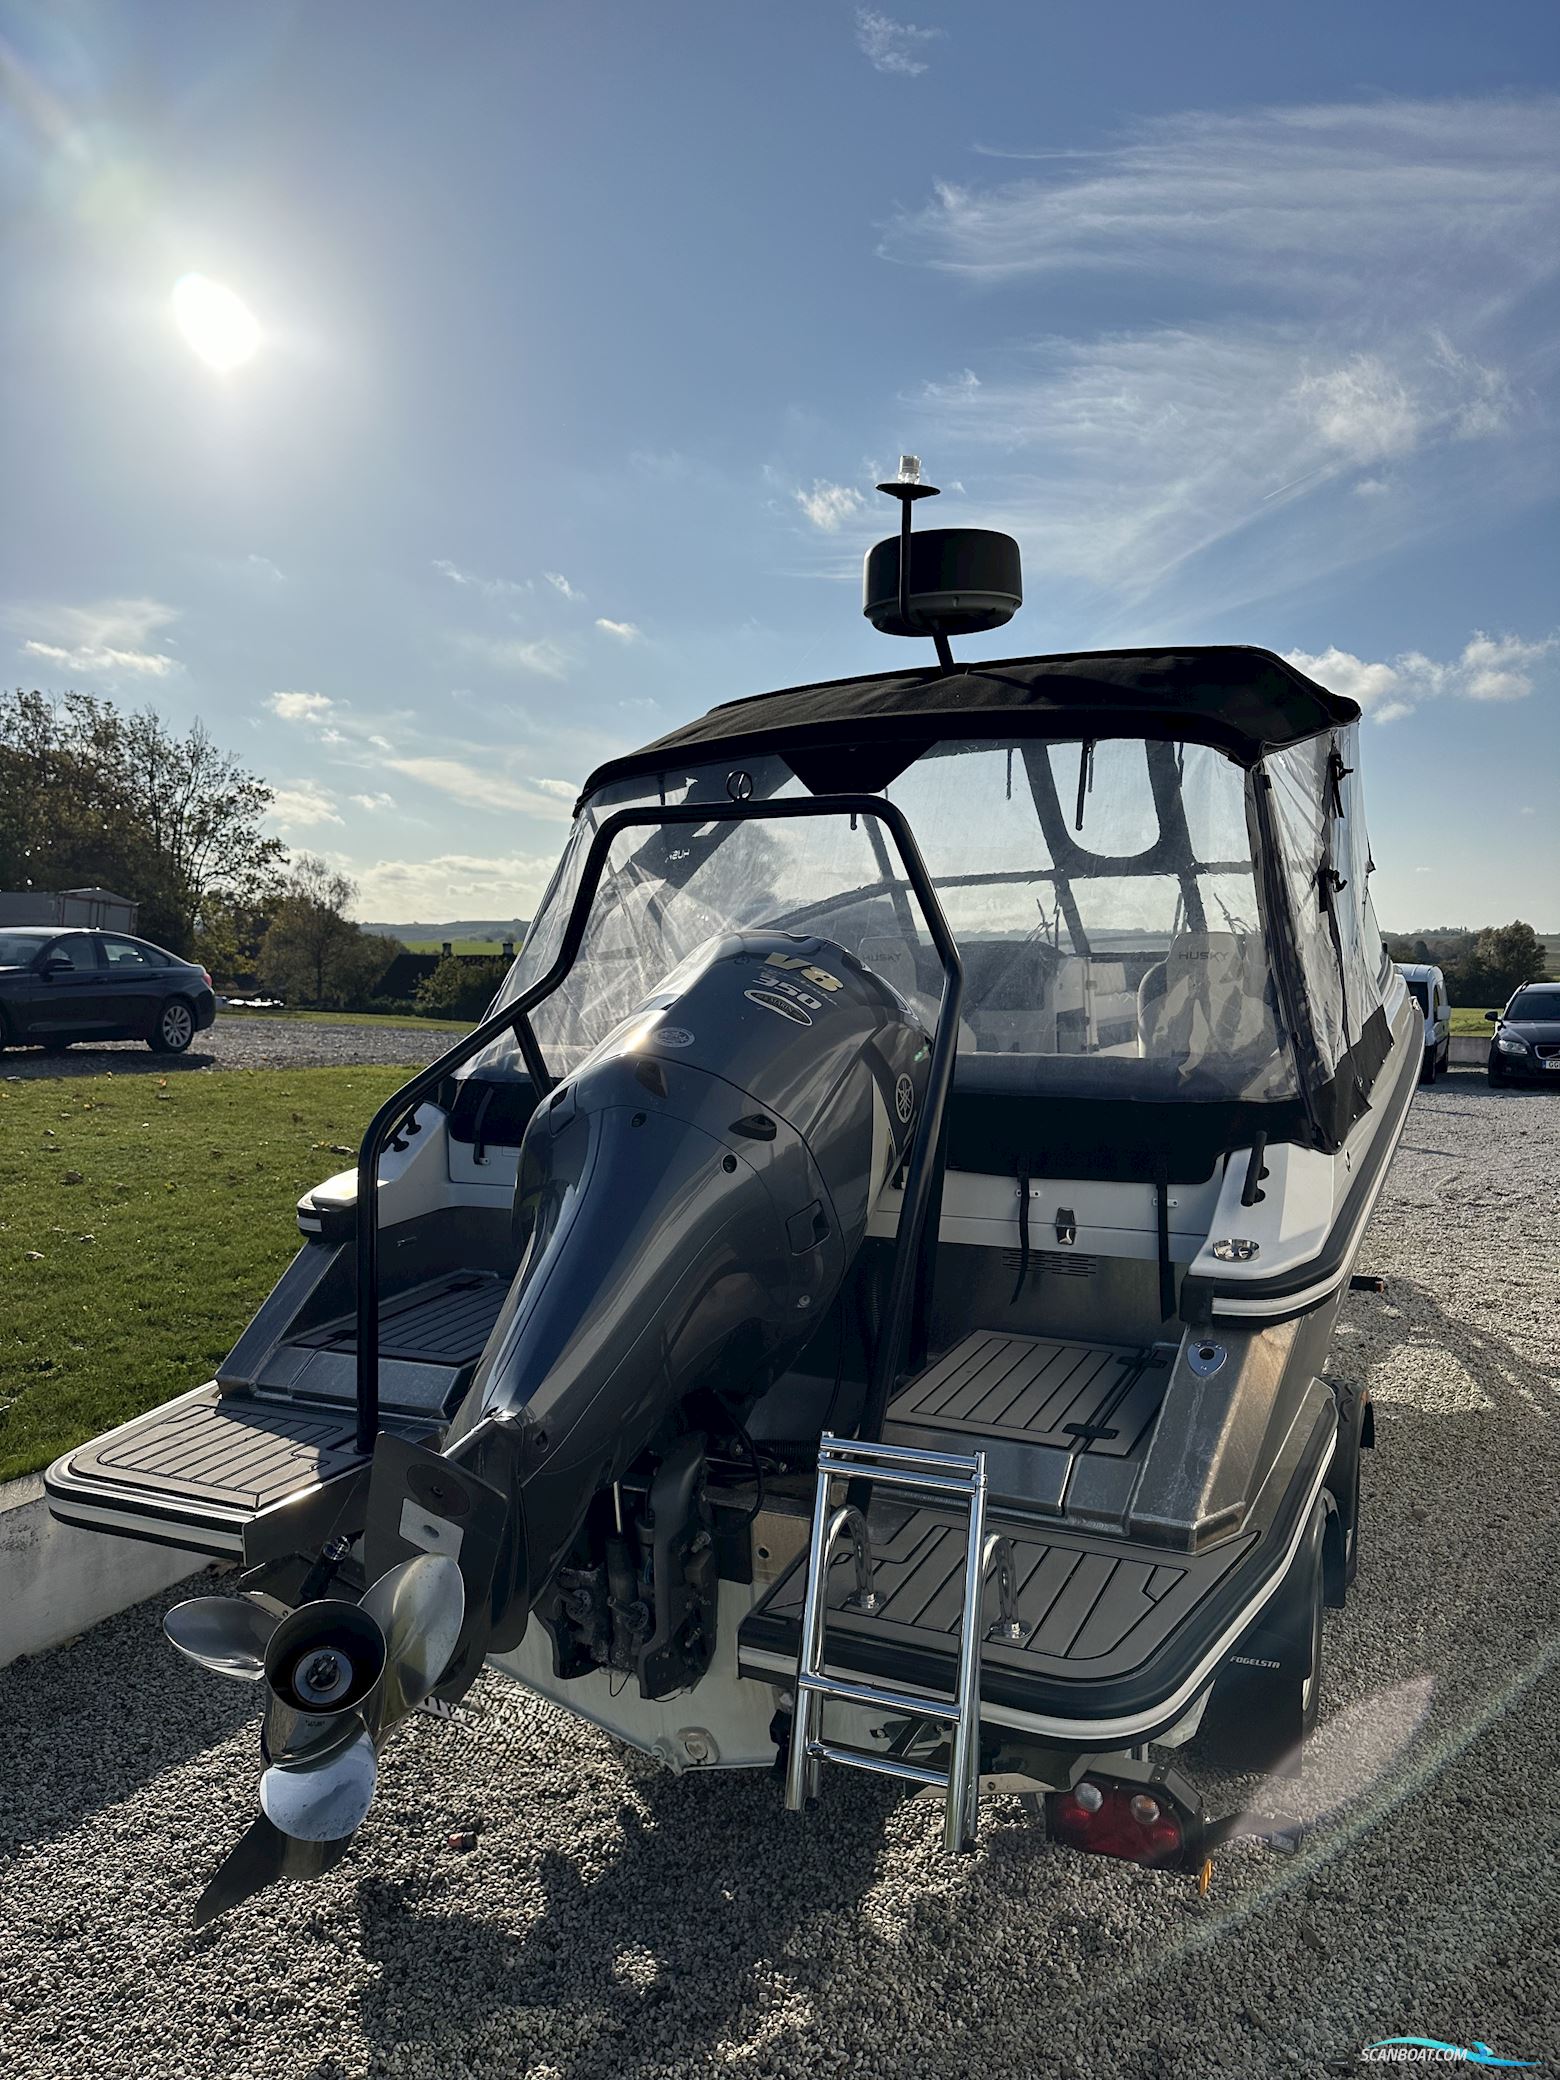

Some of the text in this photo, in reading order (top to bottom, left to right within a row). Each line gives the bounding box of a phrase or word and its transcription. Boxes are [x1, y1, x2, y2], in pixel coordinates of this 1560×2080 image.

[1178, 951, 1230, 962] HUSKY
[764, 952, 844, 992] V8
[752, 974, 822, 1010] 350
[1230, 1655, 1281, 1669] FOGELSTA
